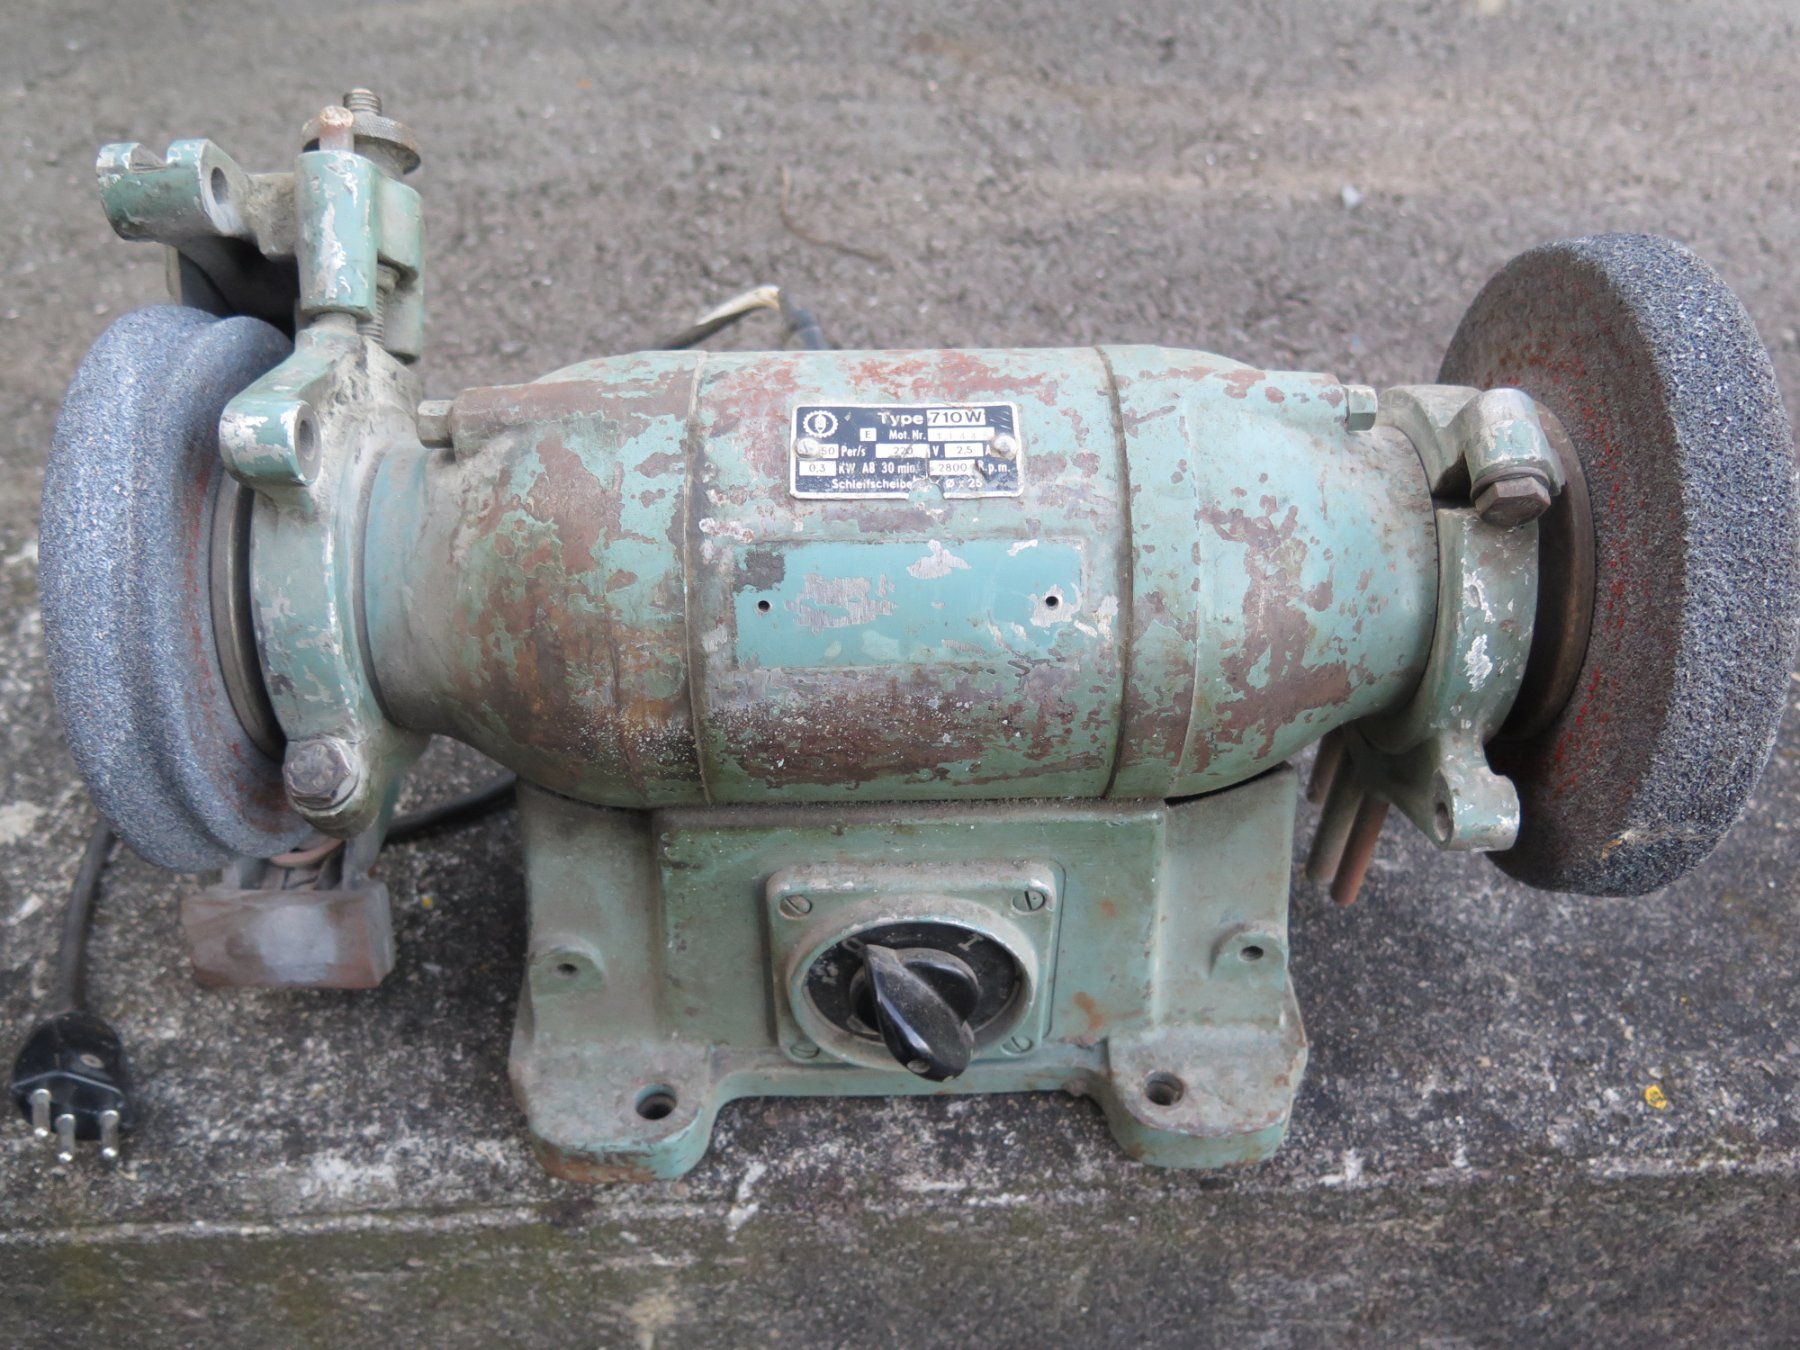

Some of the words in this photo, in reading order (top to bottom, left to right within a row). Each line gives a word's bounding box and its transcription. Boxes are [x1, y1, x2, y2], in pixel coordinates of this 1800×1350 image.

[877, 411, 923, 427] Type
[889, 429, 910, 440] Mot.
[912, 429, 926, 440] Nr.
[841, 445, 866, 457] Per/s
[893, 446, 913, 456] 220
[932, 445, 939, 456] V
[985, 444, 991, 455] A
[862, 461, 876, 474] AB
[881, 461, 895, 474] 30
[938, 463, 968, 472] 2800
